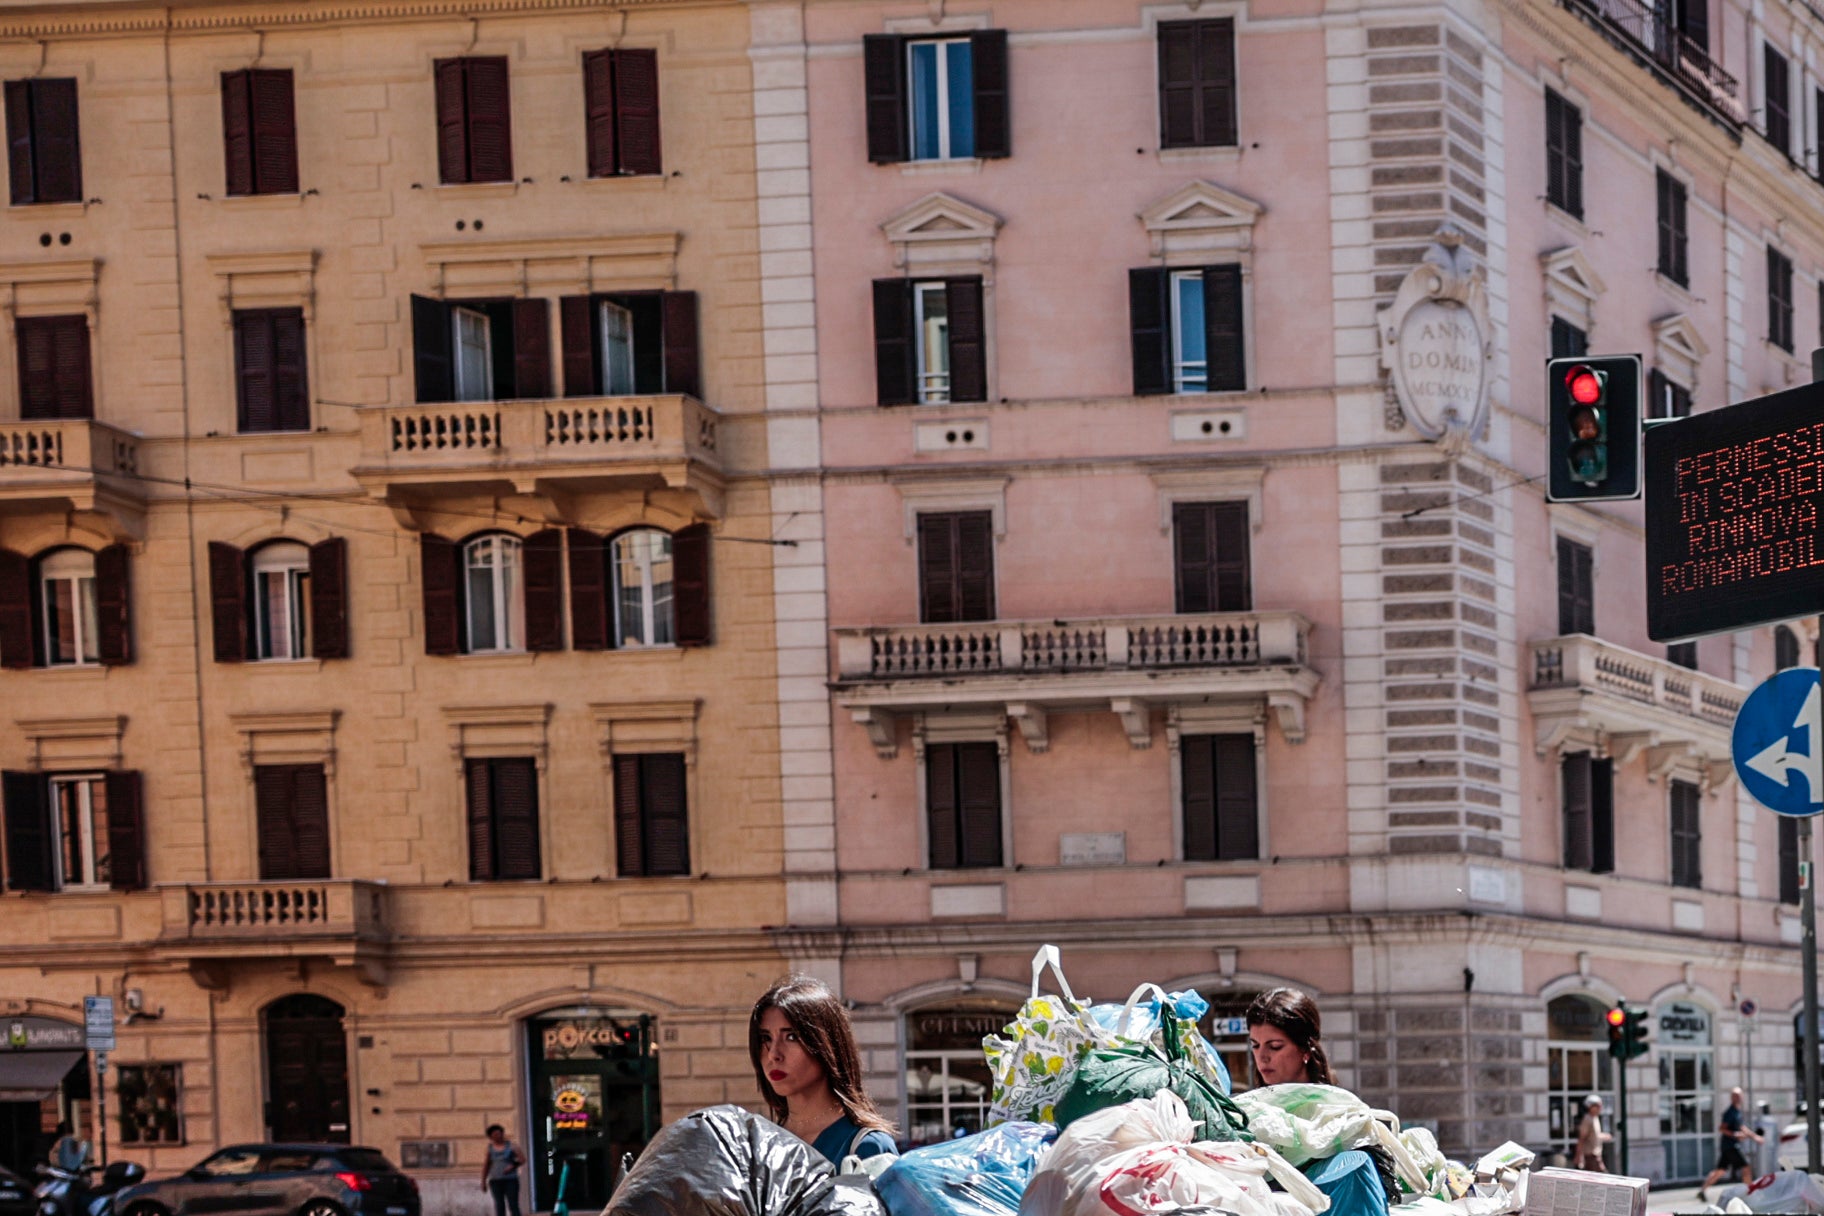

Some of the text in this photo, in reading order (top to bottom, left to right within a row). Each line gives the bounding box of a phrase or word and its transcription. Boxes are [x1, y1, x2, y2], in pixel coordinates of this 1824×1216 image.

[1678, 423, 1824, 489] PERMESSI
[1679, 488, 1709, 523] IN
[1688, 499, 1816, 556] RINNOVA
